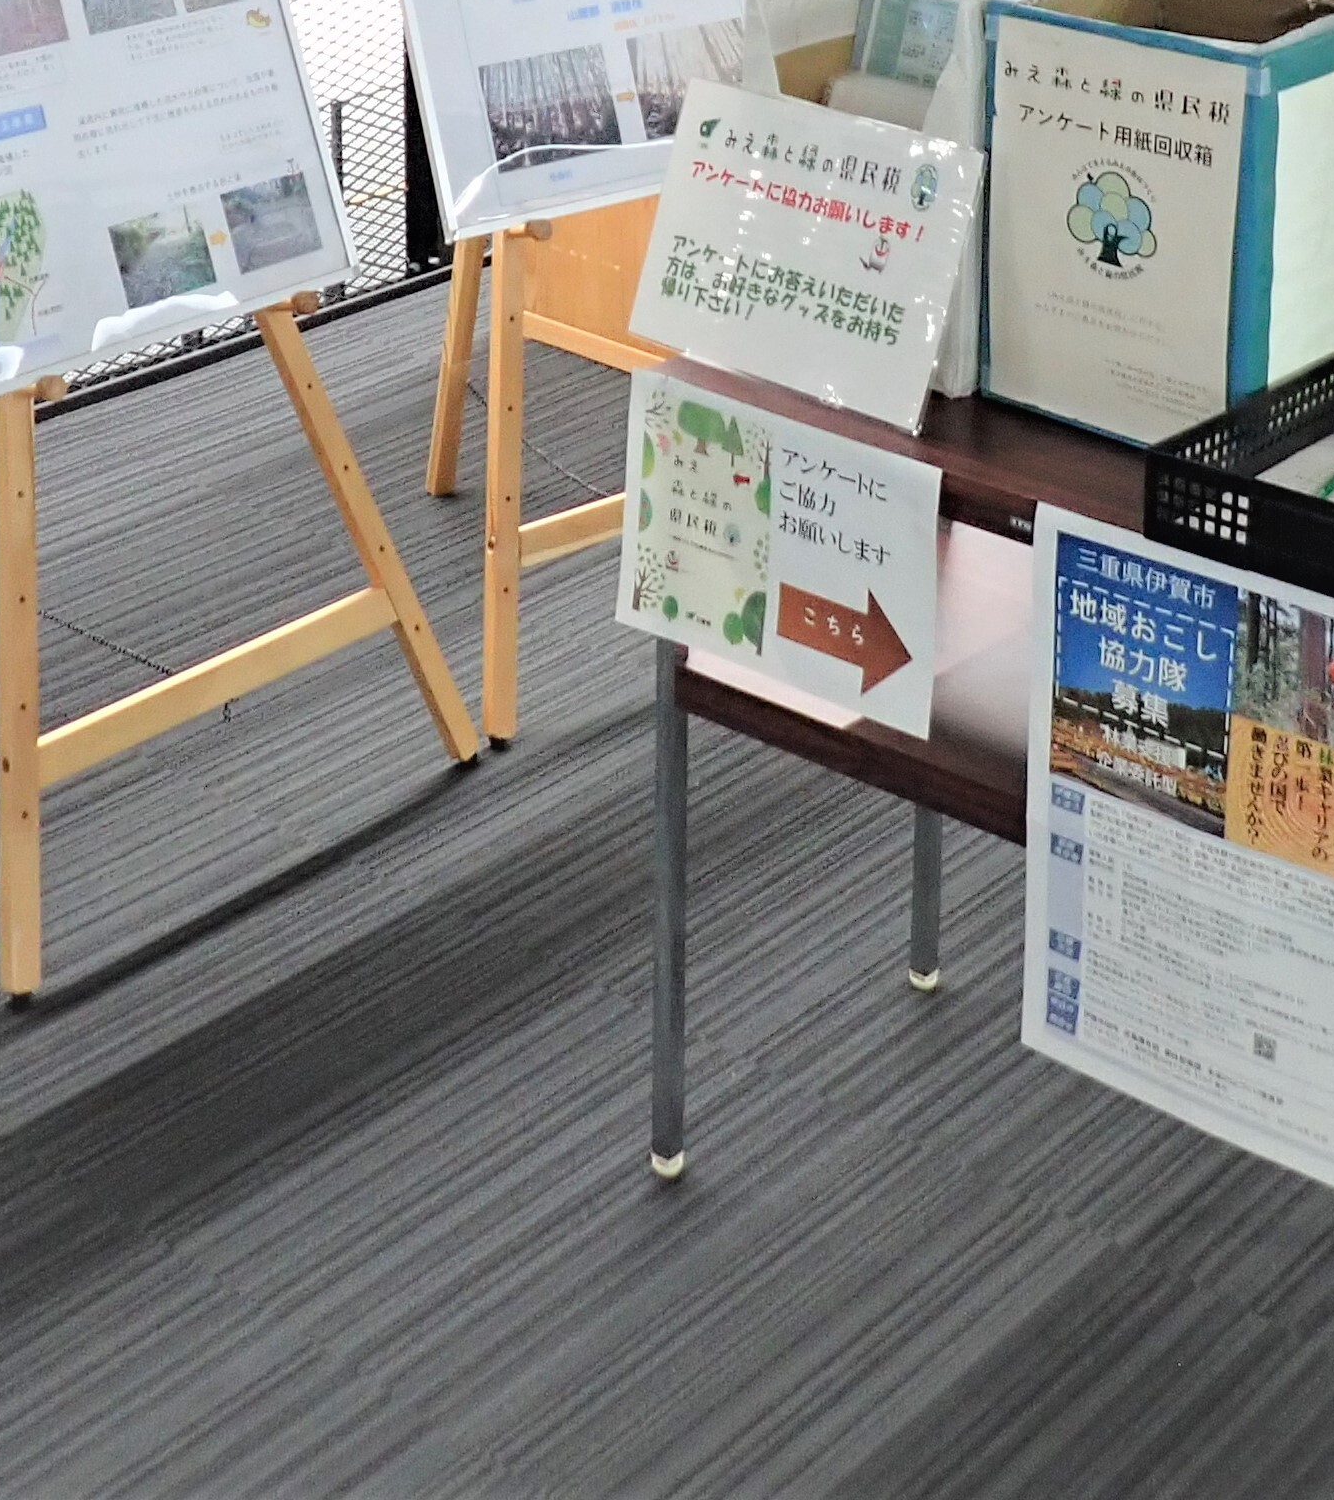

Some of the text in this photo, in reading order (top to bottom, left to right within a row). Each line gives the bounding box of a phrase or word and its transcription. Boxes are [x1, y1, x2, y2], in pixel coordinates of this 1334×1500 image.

[1004, 56, 1231, 126] みえ森と緑の県民税
[722, 122, 903, 195] みえ森と緑の県民税
[1017, 102, 1212, 168] アンケート用紙回収箱
[688, 159, 926, 245] アンケートに協力お願いします！
[658, 276, 755, 325] 帰り下さい！
[664, 255, 900, 347] 方は、お好きなグッズをお持ち
[669, 234, 905, 325] アンケトにお答えいただいた
[779, 478, 835, 518] ご協力
[780, 447, 888, 501] アンケートに
[778, 510, 891, 569] お願いします
[1076, 545, 1215, 612] 三重県伊賀市
[803, 605, 866, 649] こちら
[1069, 589, 1217, 664] 地域おこし
[1098, 635, 1186, 693] 協力隊
[1111, 679, 1169, 729] 募集
